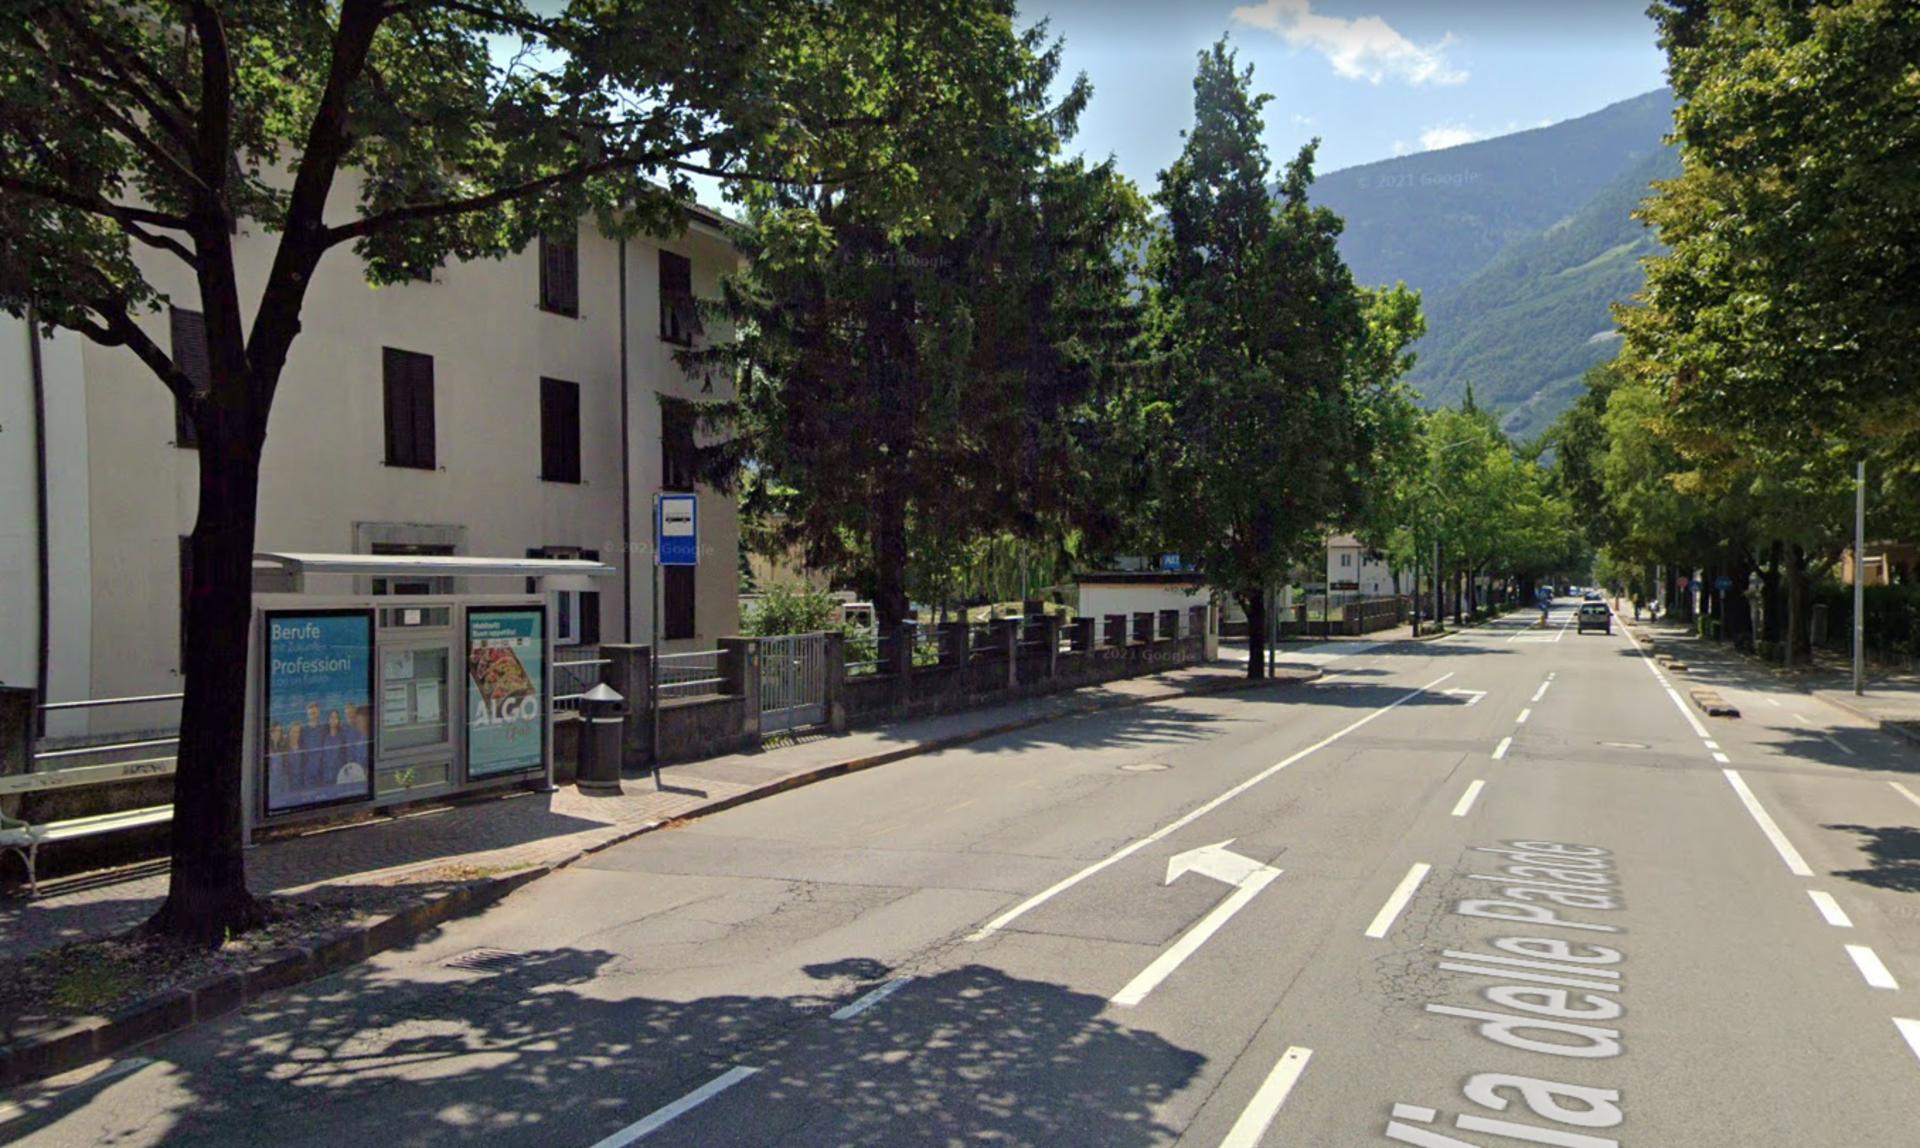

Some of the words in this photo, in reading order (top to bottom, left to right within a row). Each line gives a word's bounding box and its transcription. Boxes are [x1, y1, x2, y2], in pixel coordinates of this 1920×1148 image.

[271, 622, 320, 641] Berufe
[271, 654, 352, 675] Professioni
[474, 694, 538, 726] ALGO
